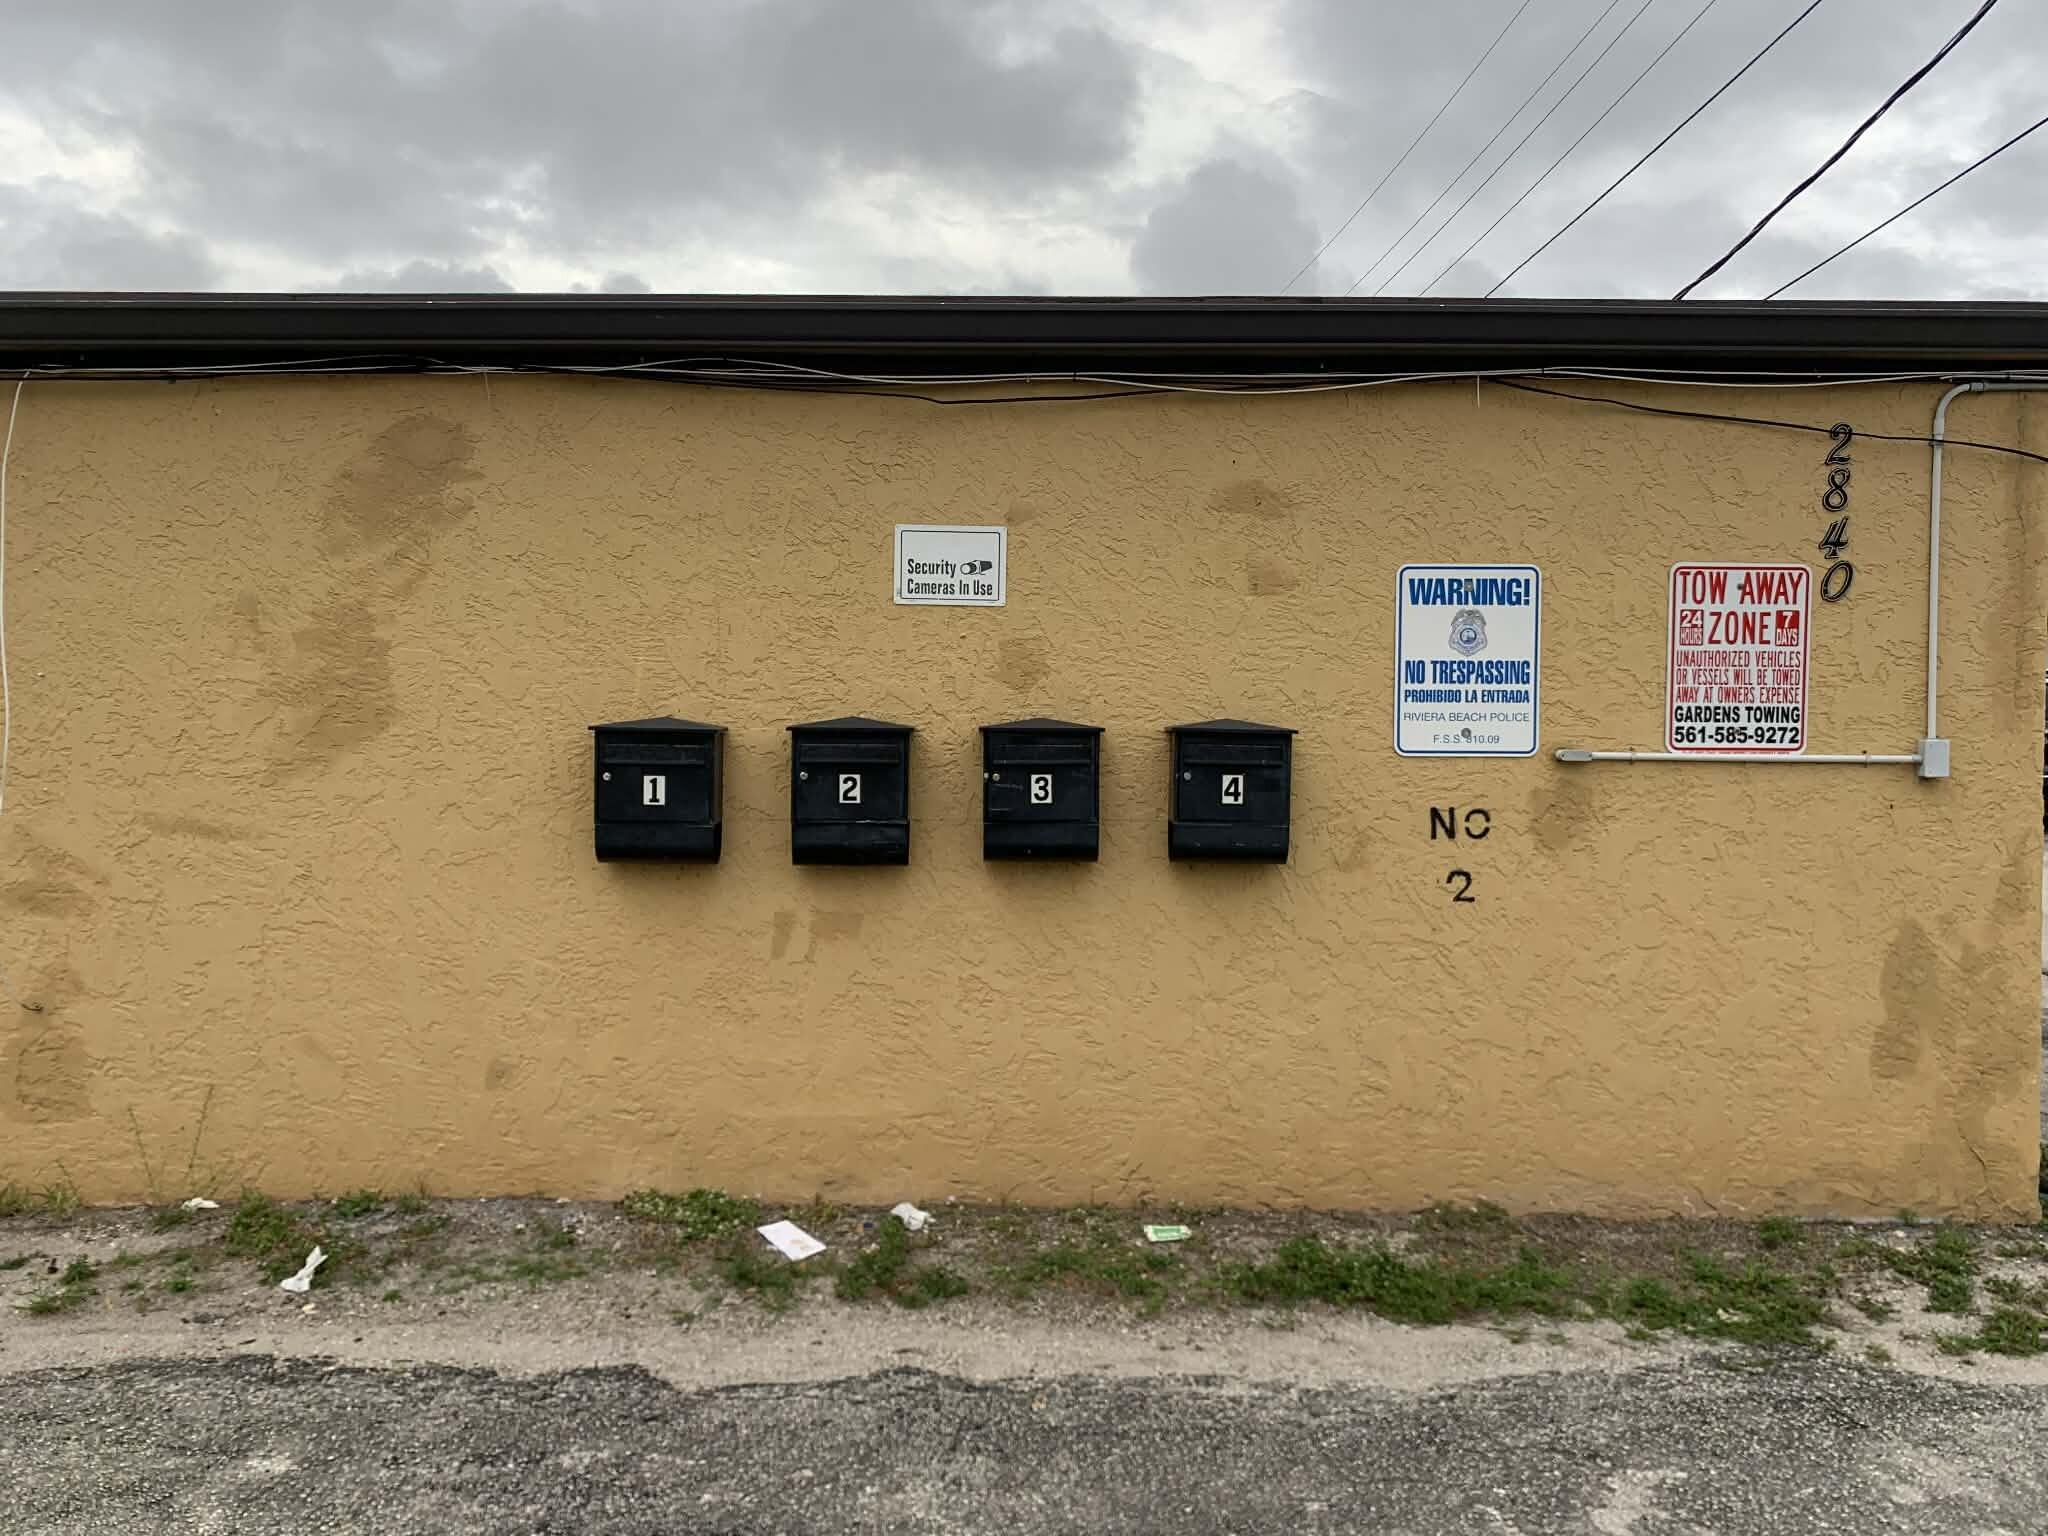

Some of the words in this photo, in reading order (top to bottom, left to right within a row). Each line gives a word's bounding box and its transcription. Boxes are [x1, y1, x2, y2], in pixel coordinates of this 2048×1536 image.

[1819, 423, 1853, 602] 2840
[907, 559, 956, 578] Security
[907, 579, 955, 595] Cameras
[959, 580, 969, 595] In
[973, 580, 993, 596] Use
[1408, 578, 1530, 606] WARNING!
[1679, 571, 1728, 605] TOW
[1739, 572, 1804, 605] AWAY
[1681, 611, 1703, 627] 24
[1708, 611, 1771, 645] ZONE
[1782, 612, 1793, 628] 7
[1680, 628, 1703, 645] HOURS
[1776, 629, 1798, 646] DAYS
[1676, 651, 1750, 667] UNAUTHORIZED
[1755, 651, 1801, 668] VEHICLES
[1405, 660, 1425, 685] NO
[1431, 660, 1531, 685] TRESPASSING
[1676, 669, 1687, 685] OR
[1692, 669, 1729, 685] VESSELS
[1733, 669, 1753, 686] WILL
[1757, 669, 1768, 686] BE
[1772, 669, 1800, 686] TOWED
[1404, 689, 1461, 704] PROHIBIDO
[1465, 690, 1478, 704] LA
[1481, 690, 1530, 704] ENTRADA
[1676, 687, 1700, 703] AWAY
[1703, 687, 1714, 703] AT
[1717, 687, 1755, 704] OWNERS
[1759, 687, 1800, 704] EXPENSE
[1403, 712, 1446, 722] RIVIERA
[1449, 712, 1487, 722] BEACH
[1490, 712, 1529, 722] POLICE
[1674, 706, 1741, 724] GARDENS
[1745, 706, 1801, 724] TOWING
[1674, 726, 1800, 744] 561-585-9272
[649, 777, 660, 803] 1
[842, 776, 858, 802] 2
[1033, 776, 1050, 802] 3
[1223, 777, 1241, 802] 4
[1430, 807, 1490, 840] NO
[1446, 870, 1475, 902] 2
